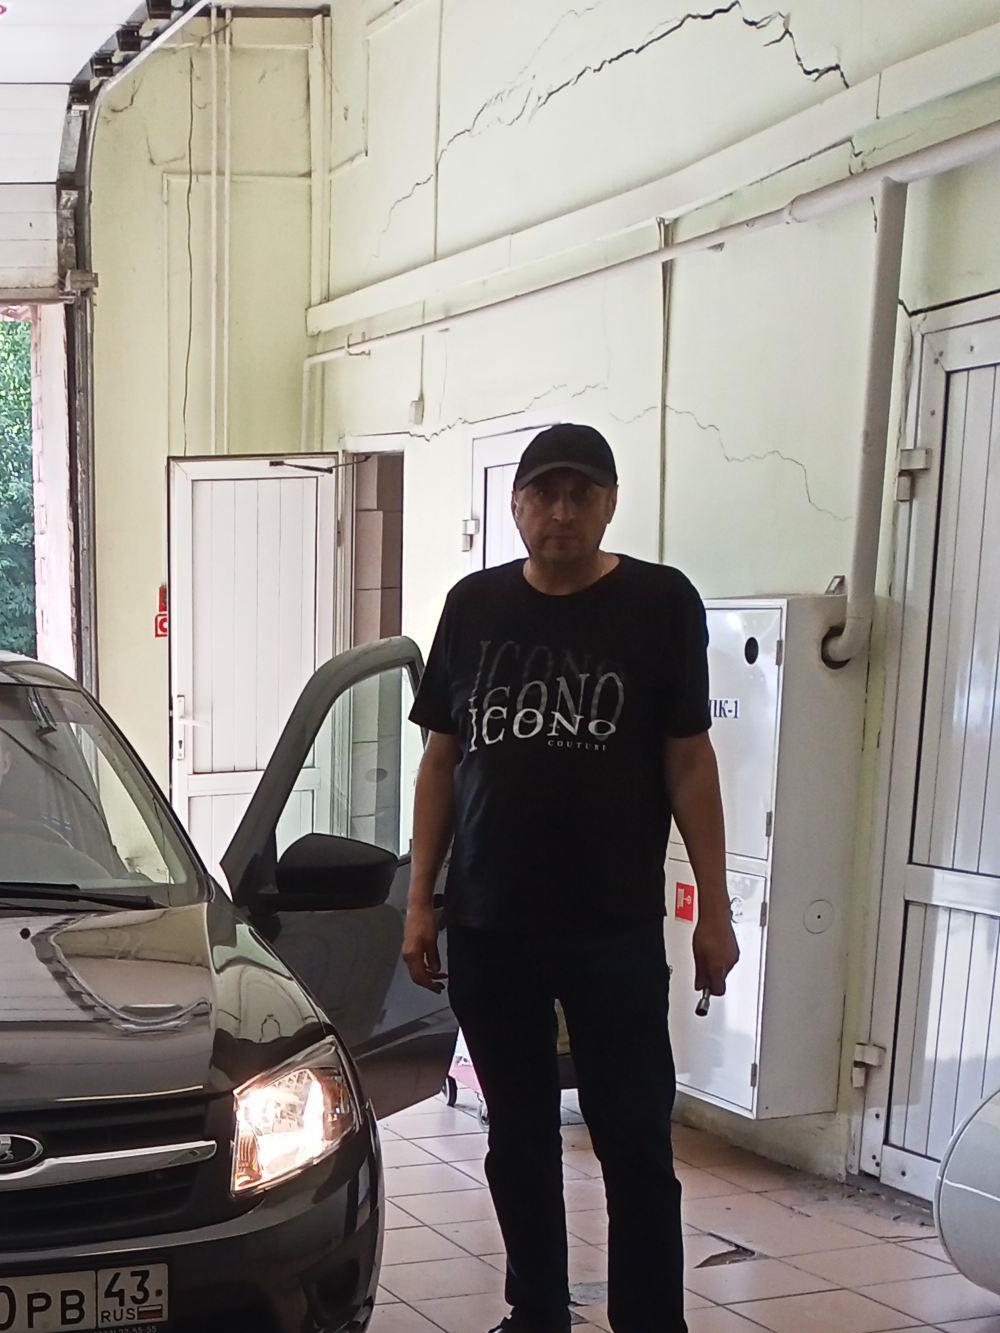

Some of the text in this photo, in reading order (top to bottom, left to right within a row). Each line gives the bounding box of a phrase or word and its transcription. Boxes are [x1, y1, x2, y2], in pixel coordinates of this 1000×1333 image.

[468, 706, 616, 752] ICONO
[104, 1270, 149, 1307] 43
[101, 1308, 136, 1323] RUS
